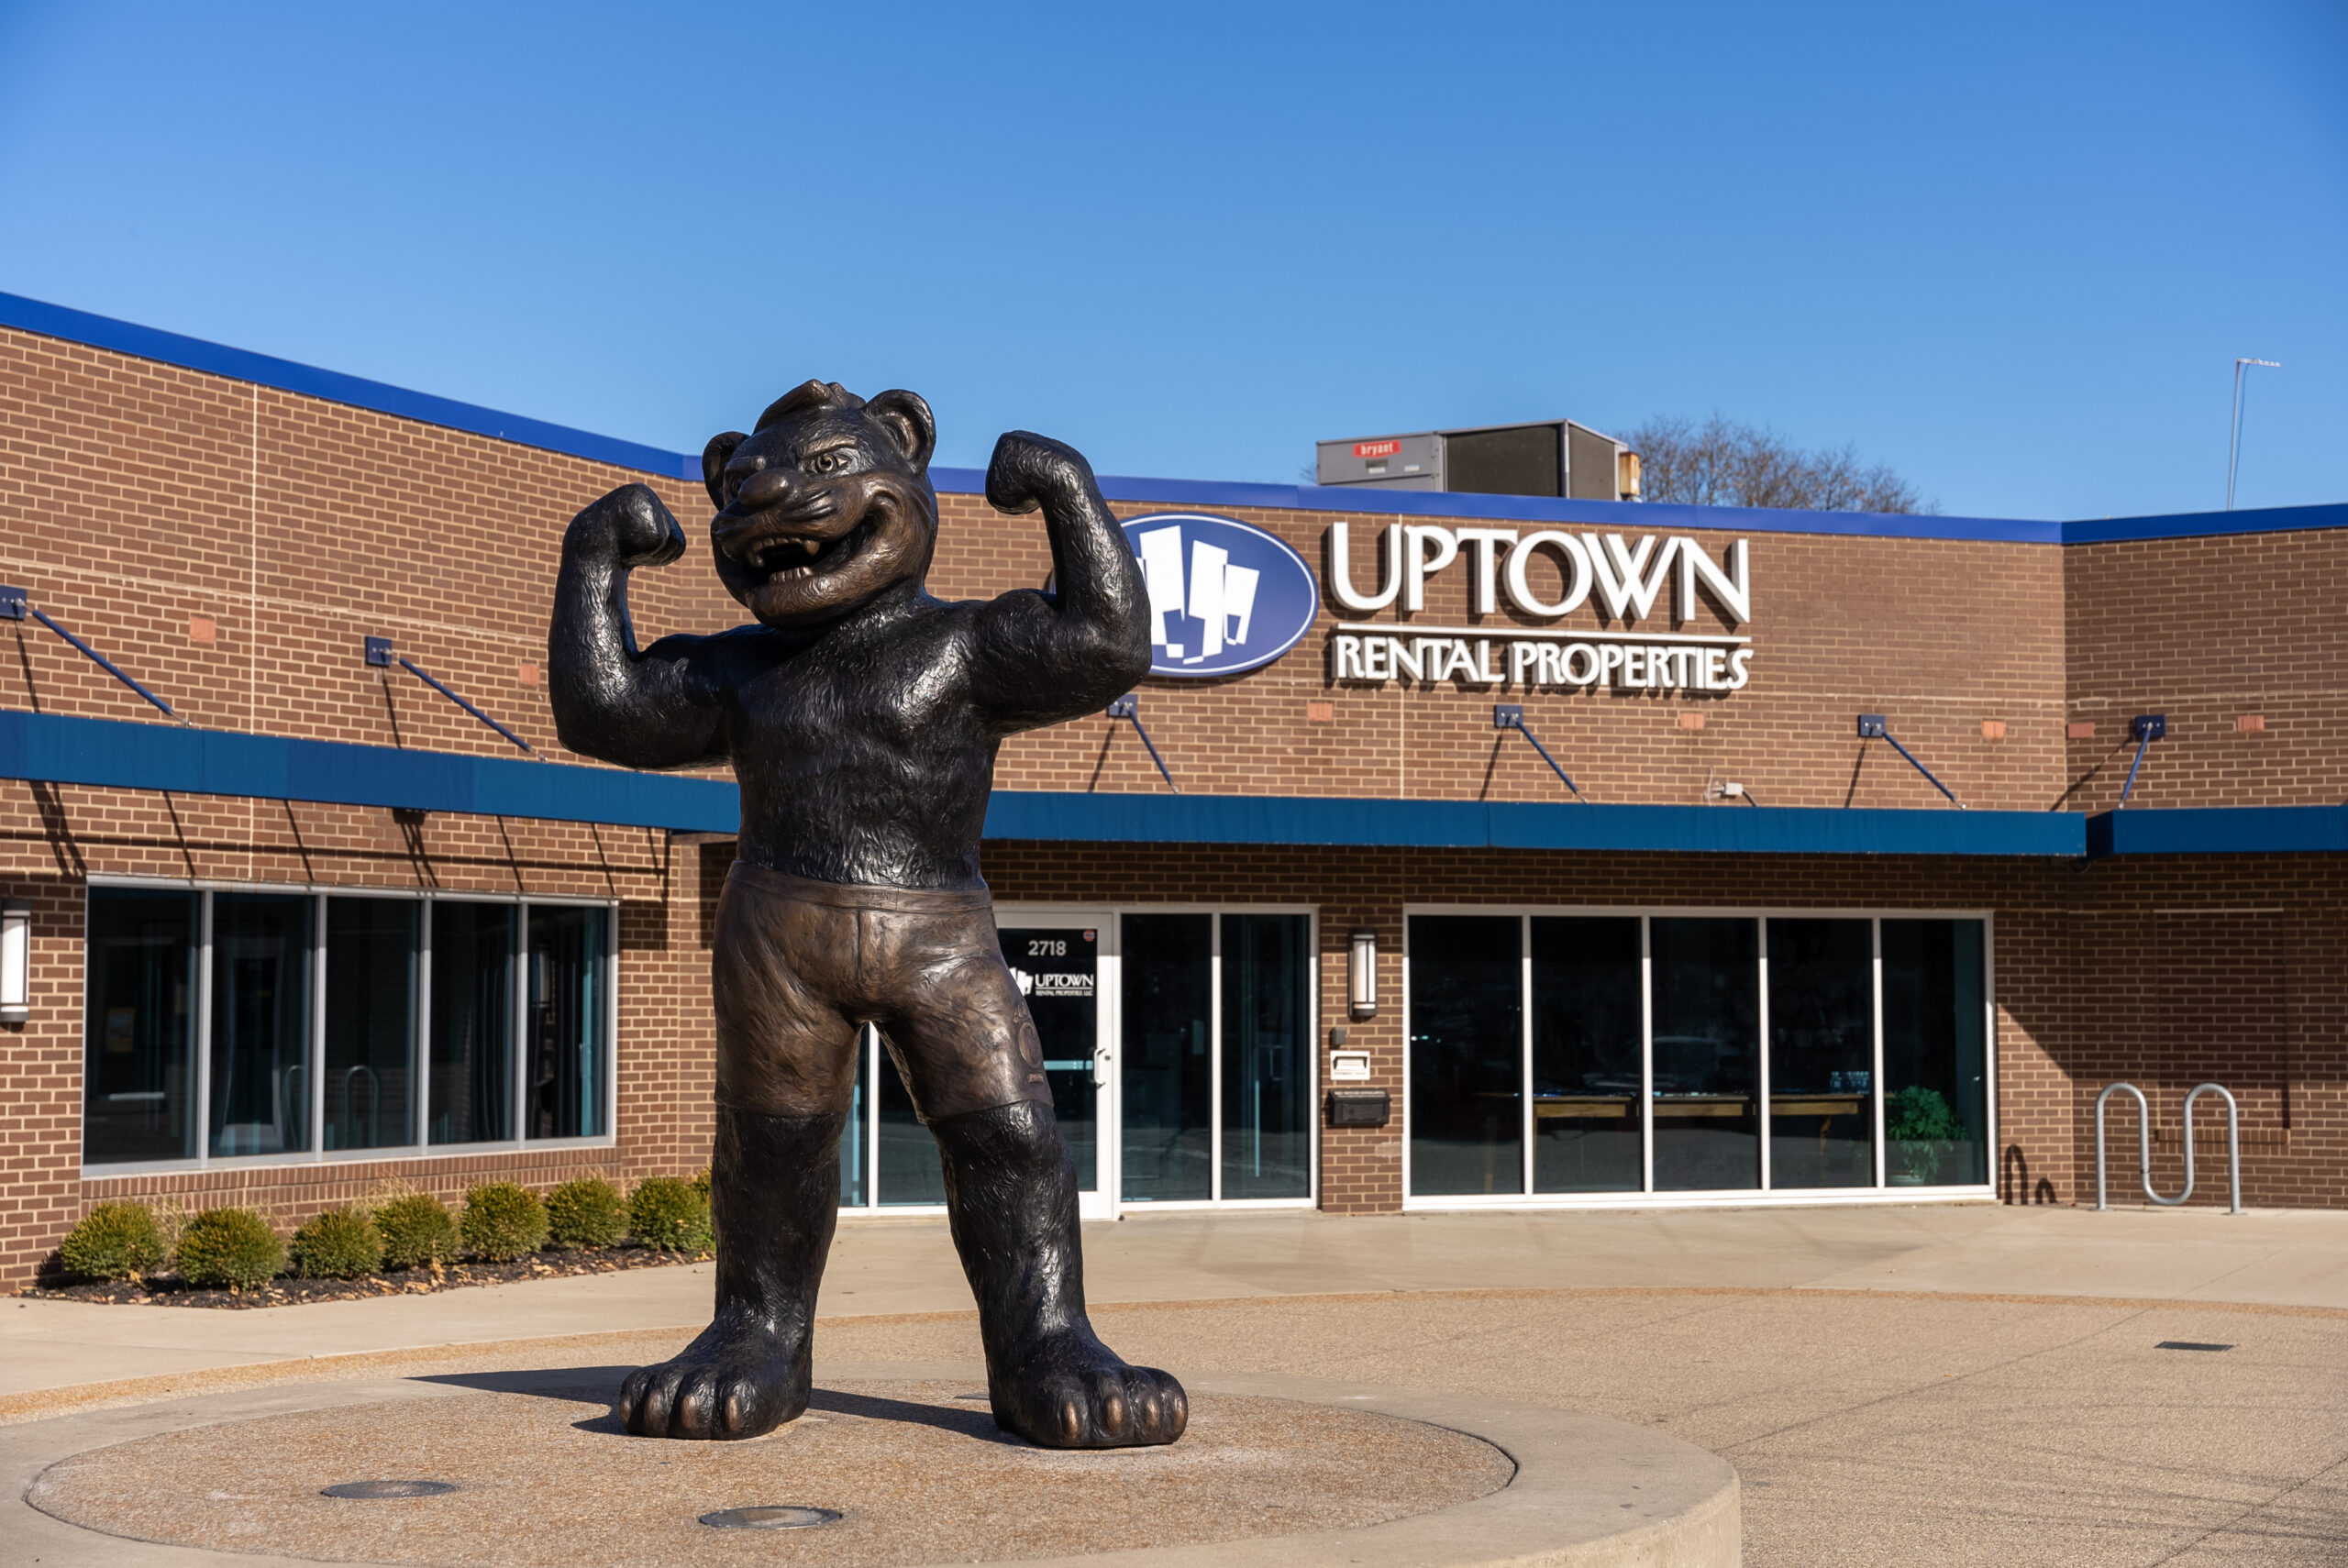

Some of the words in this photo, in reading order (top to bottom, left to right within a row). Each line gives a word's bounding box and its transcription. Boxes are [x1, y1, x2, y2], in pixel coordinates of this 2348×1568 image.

[1361, 442, 1393, 456] bryant
[1329, 522, 1750, 624] UPTOWN
[1333, 635, 1505, 683] RENTAL
[1509, 640, 1754, 690] PROPERTIES
[1028, 940, 1066, 955] 2718
[1035, 974, 1094, 988] UPTOWN
